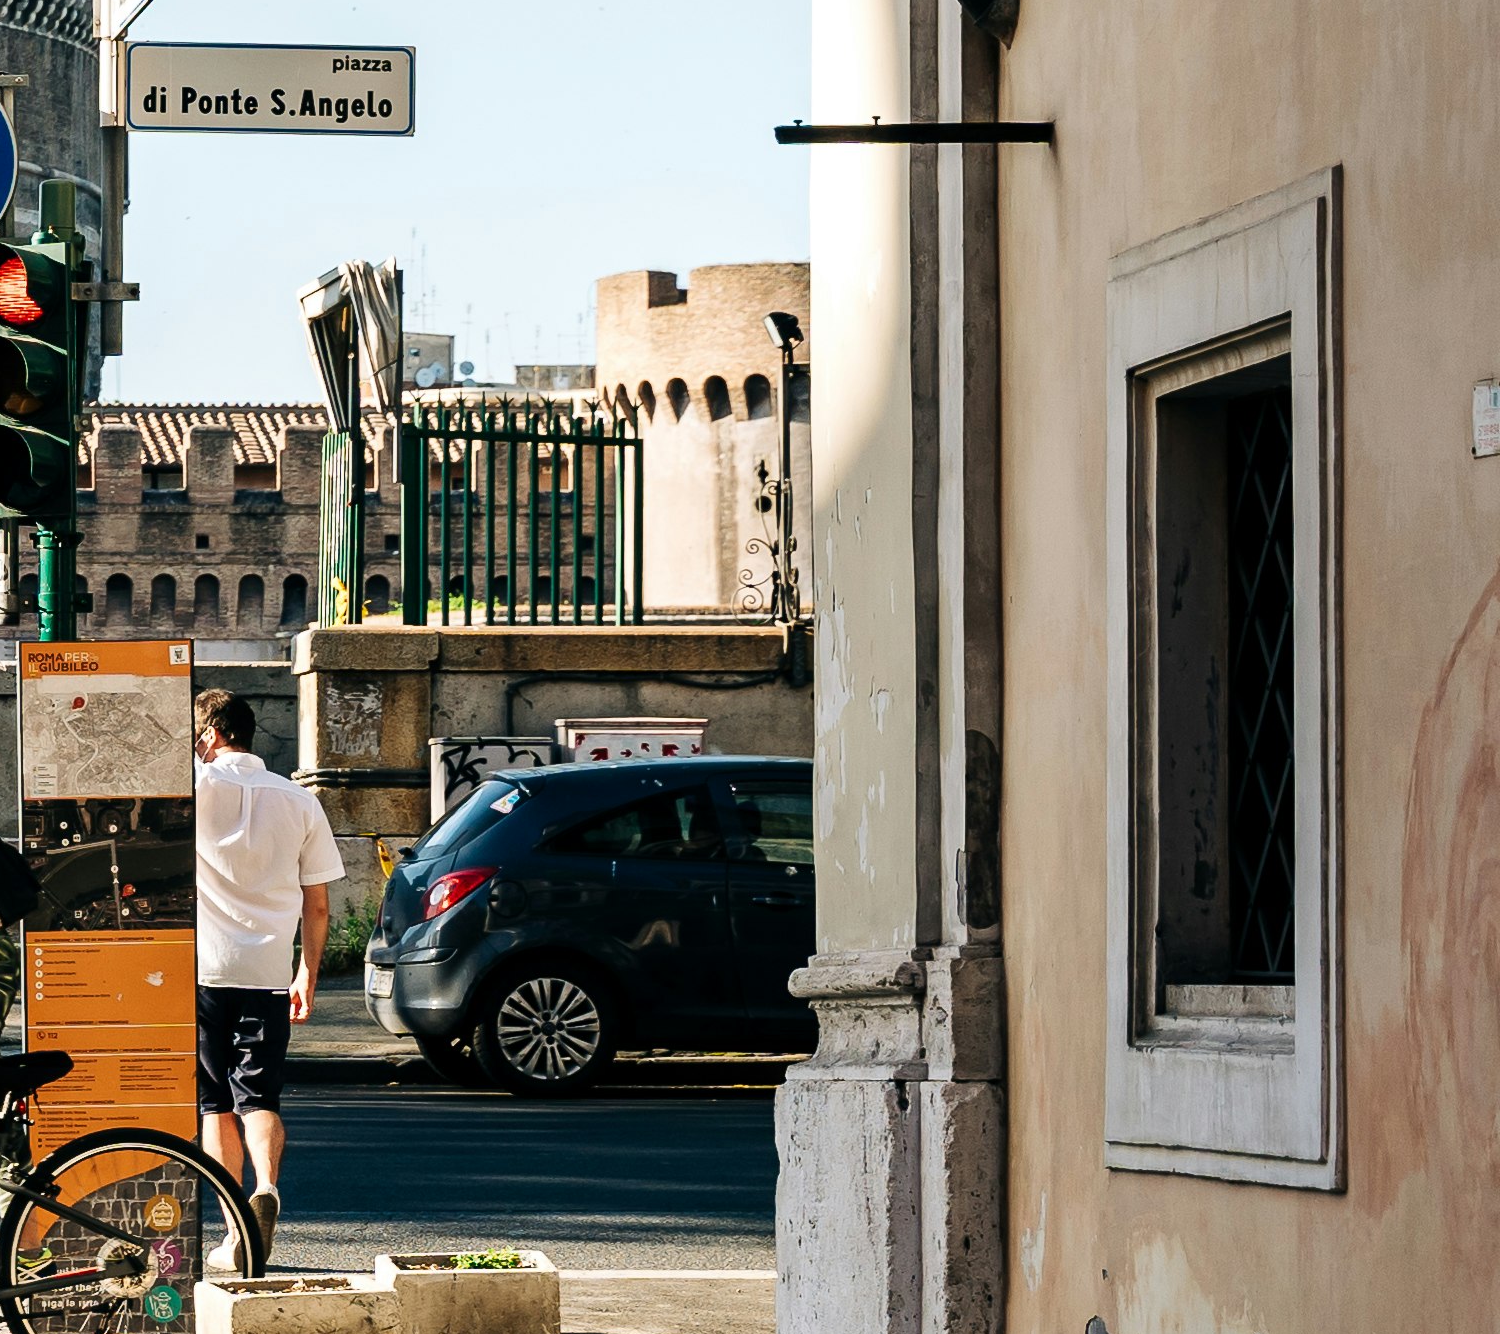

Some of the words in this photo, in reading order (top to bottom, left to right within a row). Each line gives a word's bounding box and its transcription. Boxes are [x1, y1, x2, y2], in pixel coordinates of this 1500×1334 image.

[332, 55, 393, 74] piazza
[143, 86, 167, 114] di
[181, 86, 259, 115] Ponte
